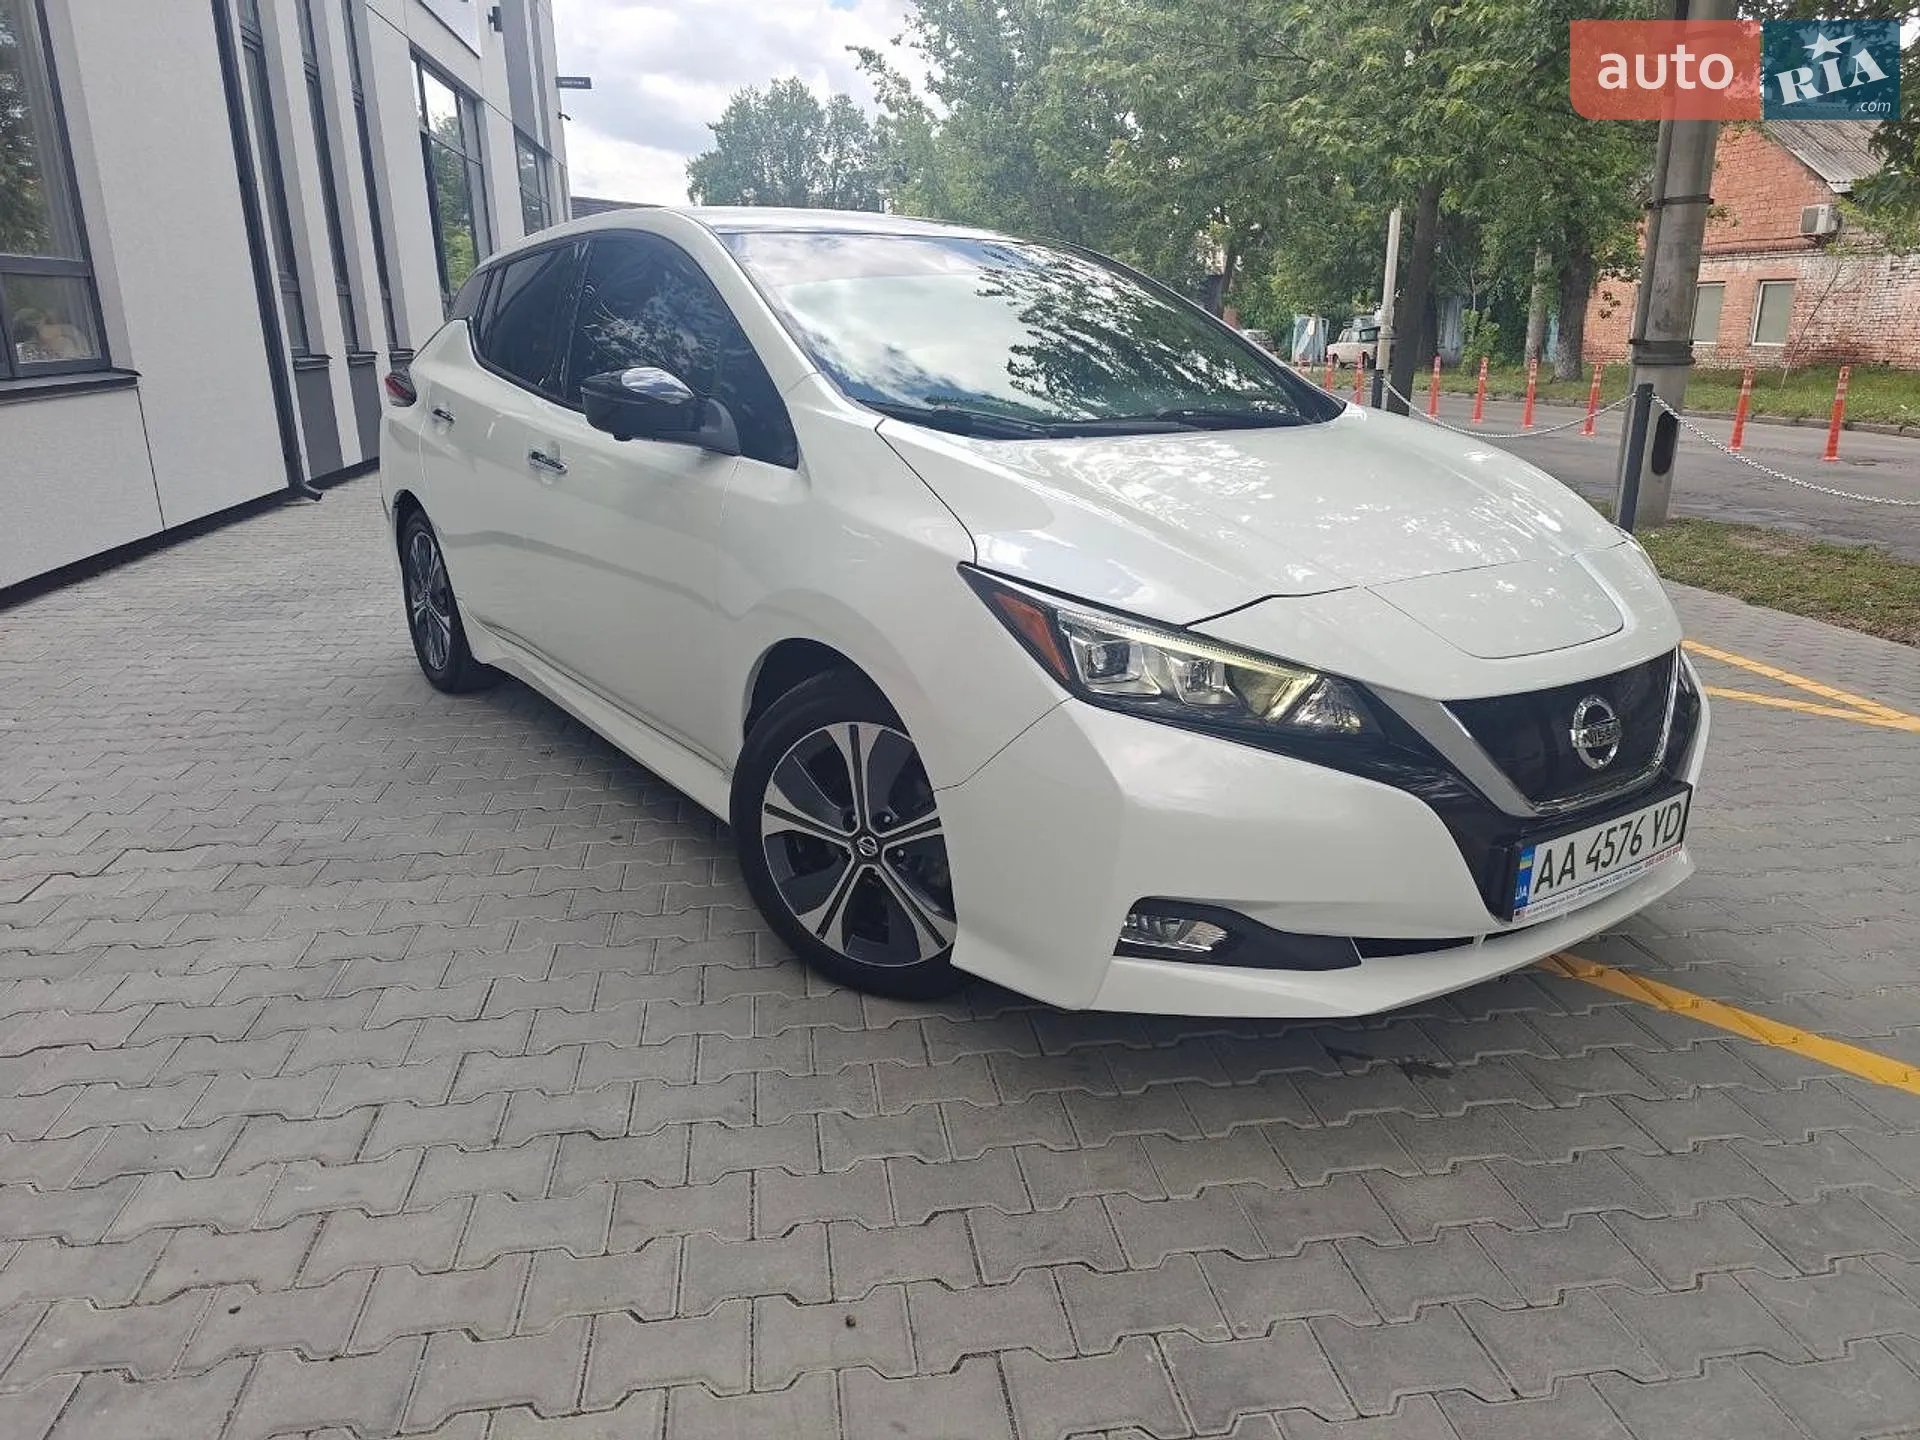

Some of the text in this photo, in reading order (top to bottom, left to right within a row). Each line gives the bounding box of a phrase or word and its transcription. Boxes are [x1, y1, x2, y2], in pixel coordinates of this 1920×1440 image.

[1534, 841, 1577, 894] AA
[1585, 815, 1646, 872] 4576
[1652, 801, 1682, 849] YD
